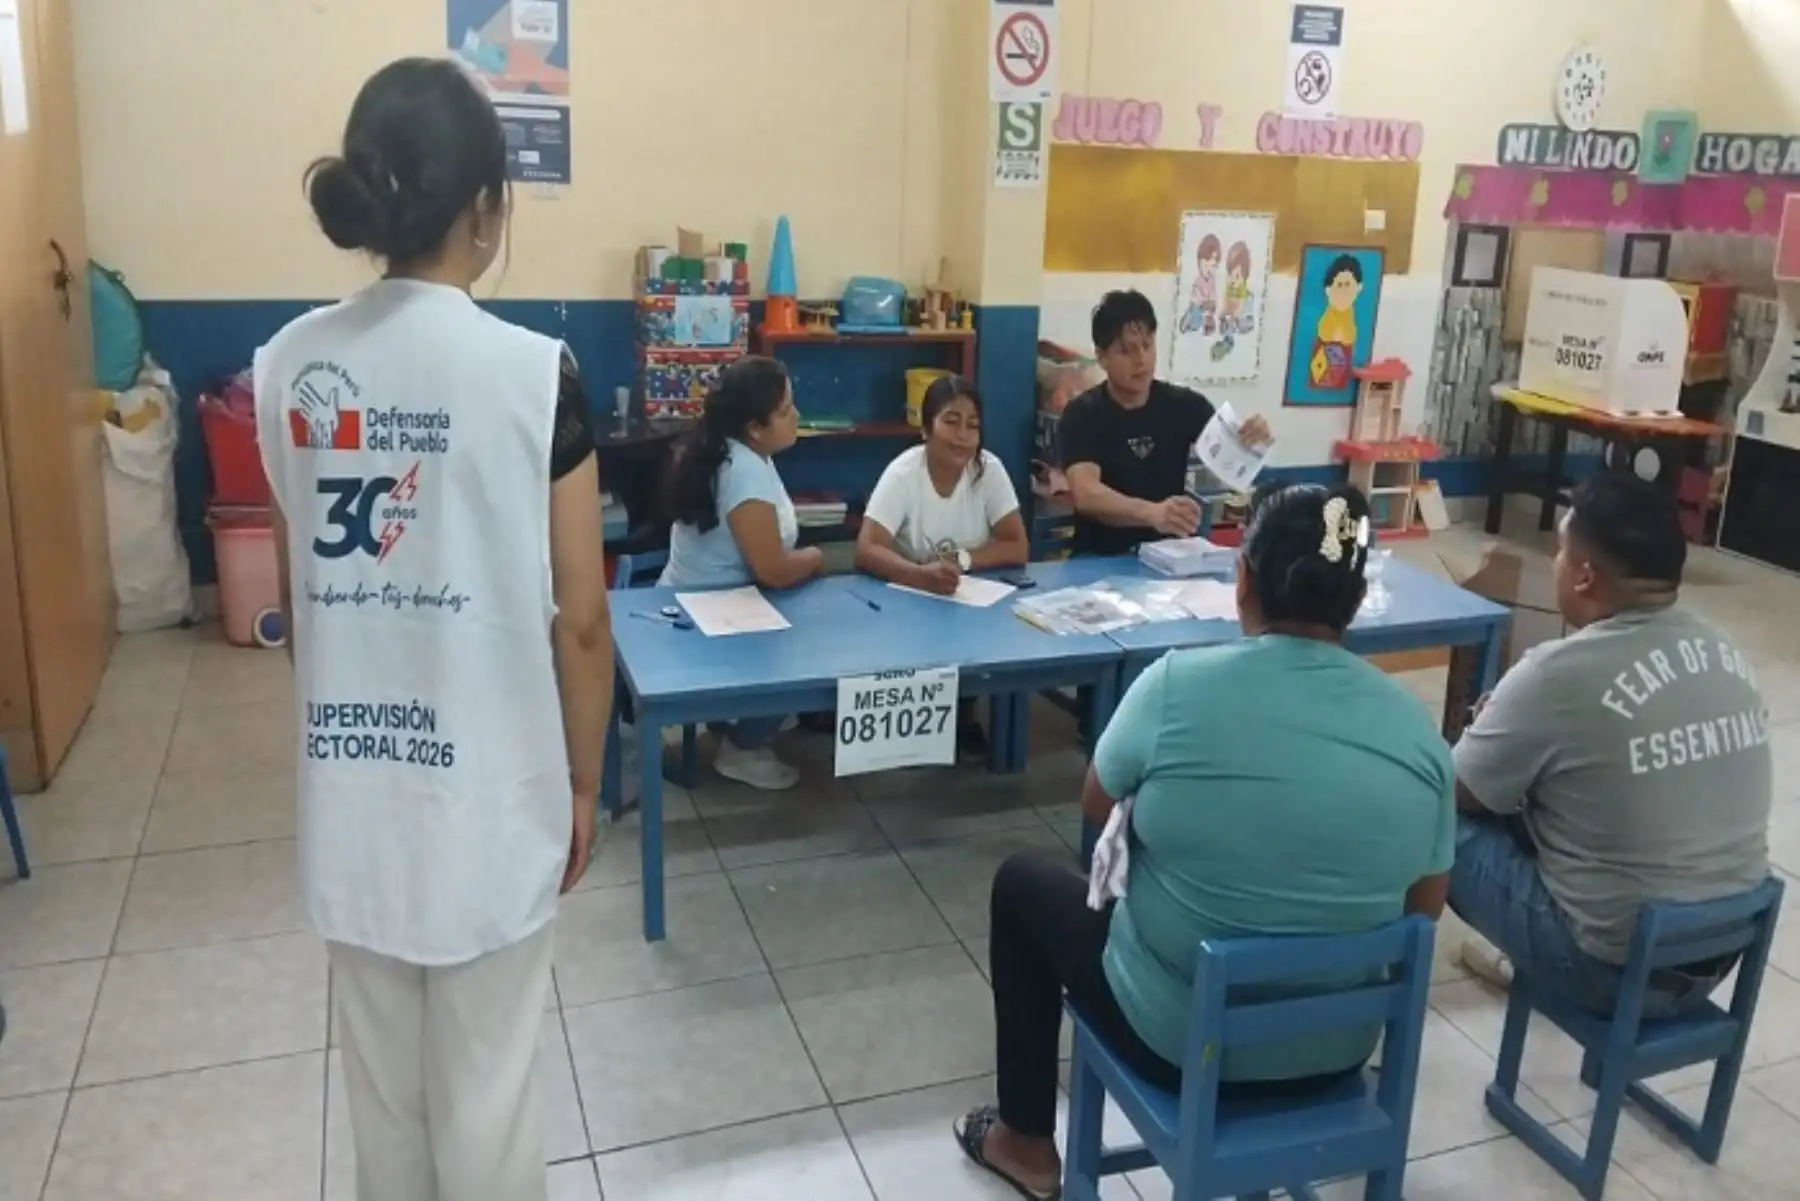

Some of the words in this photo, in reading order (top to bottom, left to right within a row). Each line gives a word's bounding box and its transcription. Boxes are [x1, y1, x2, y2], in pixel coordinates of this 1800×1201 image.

[1005, 104, 1035, 147] S
[1053, 93, 1162, 146] JUEGO
[1197, 102, 1222, 149] Y
[1503, 127, 1538, 164] MI
[1544, 131, 1637, 170] LINDO
[1554, 347, 1603, 371] 081027
[367, 430, 393, 451] del
[400, 430, 449, 453] Pueblo
[382, 506, 417, 520] años
[1601, 649, 1677, 720] FEAR
[1677, 638, 1708, 675] OF
[853, 687, 915, 710] MESA
[839, 705, 952, 745] 081027
[406, 737, 455, 768] 2026
